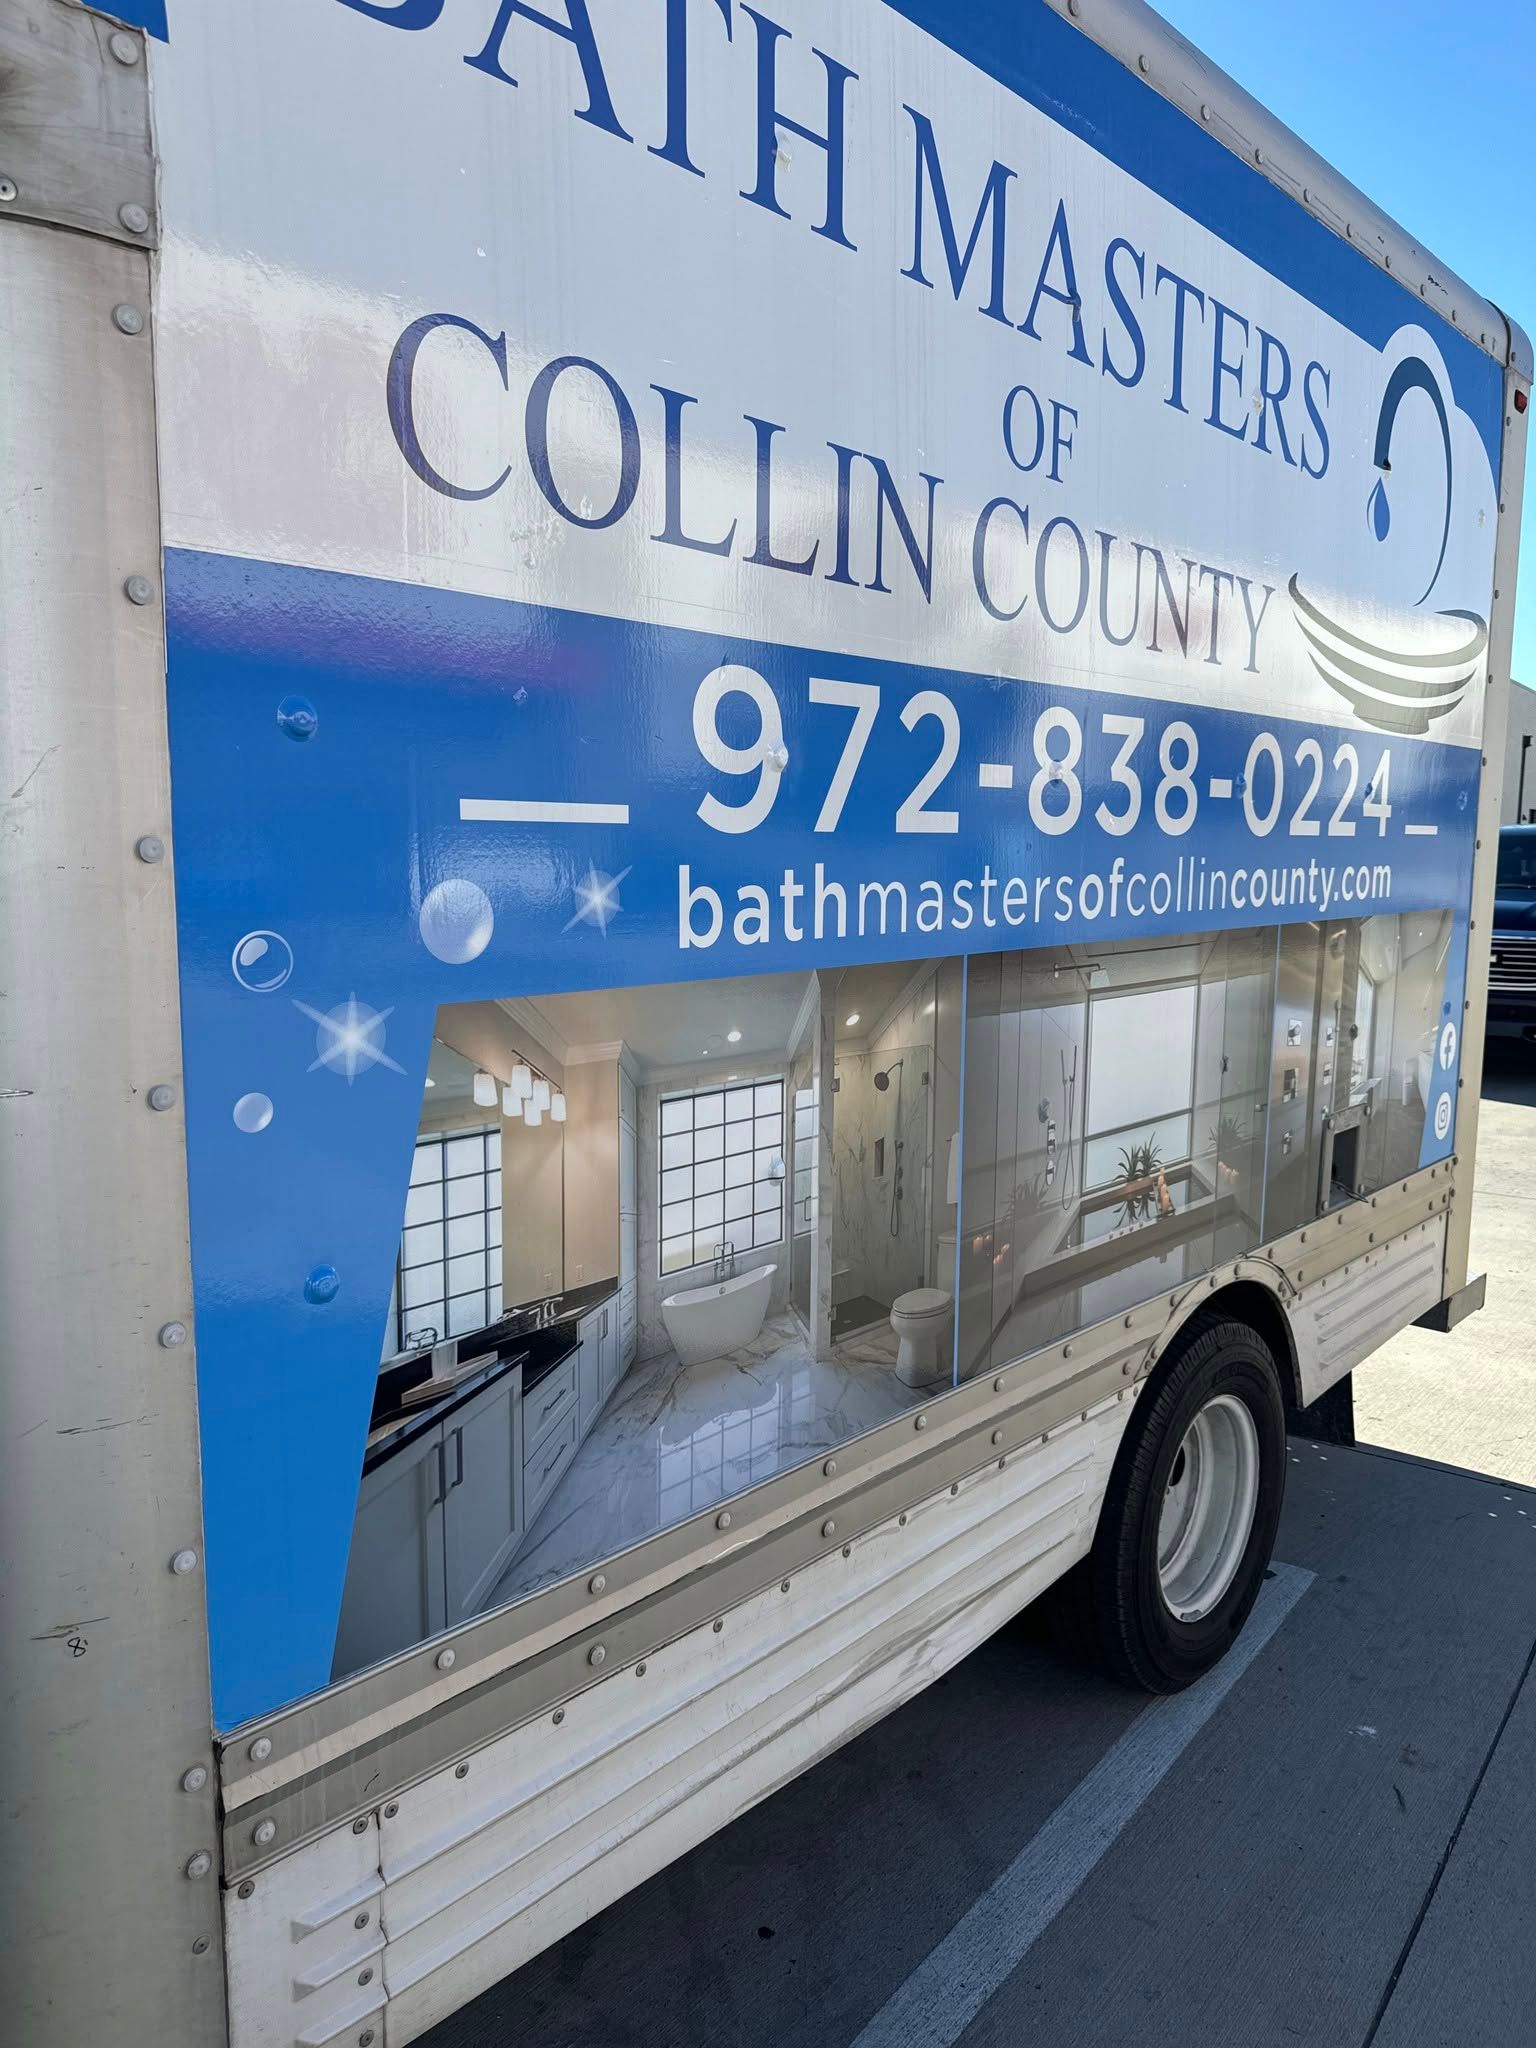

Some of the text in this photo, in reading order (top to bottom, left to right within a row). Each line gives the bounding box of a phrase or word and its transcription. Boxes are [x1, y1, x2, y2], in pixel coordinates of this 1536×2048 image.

[337, 0, 1332, 479] ATH MASTERS
[387, 313, 1276, 673] COLLIN COUNTY
[1003, 385, 1079, 482] OF
[692, 665, 1393, 837] 972-838-0224
[677, 857, 1392, 949] bathmastersofcollincounty.com
